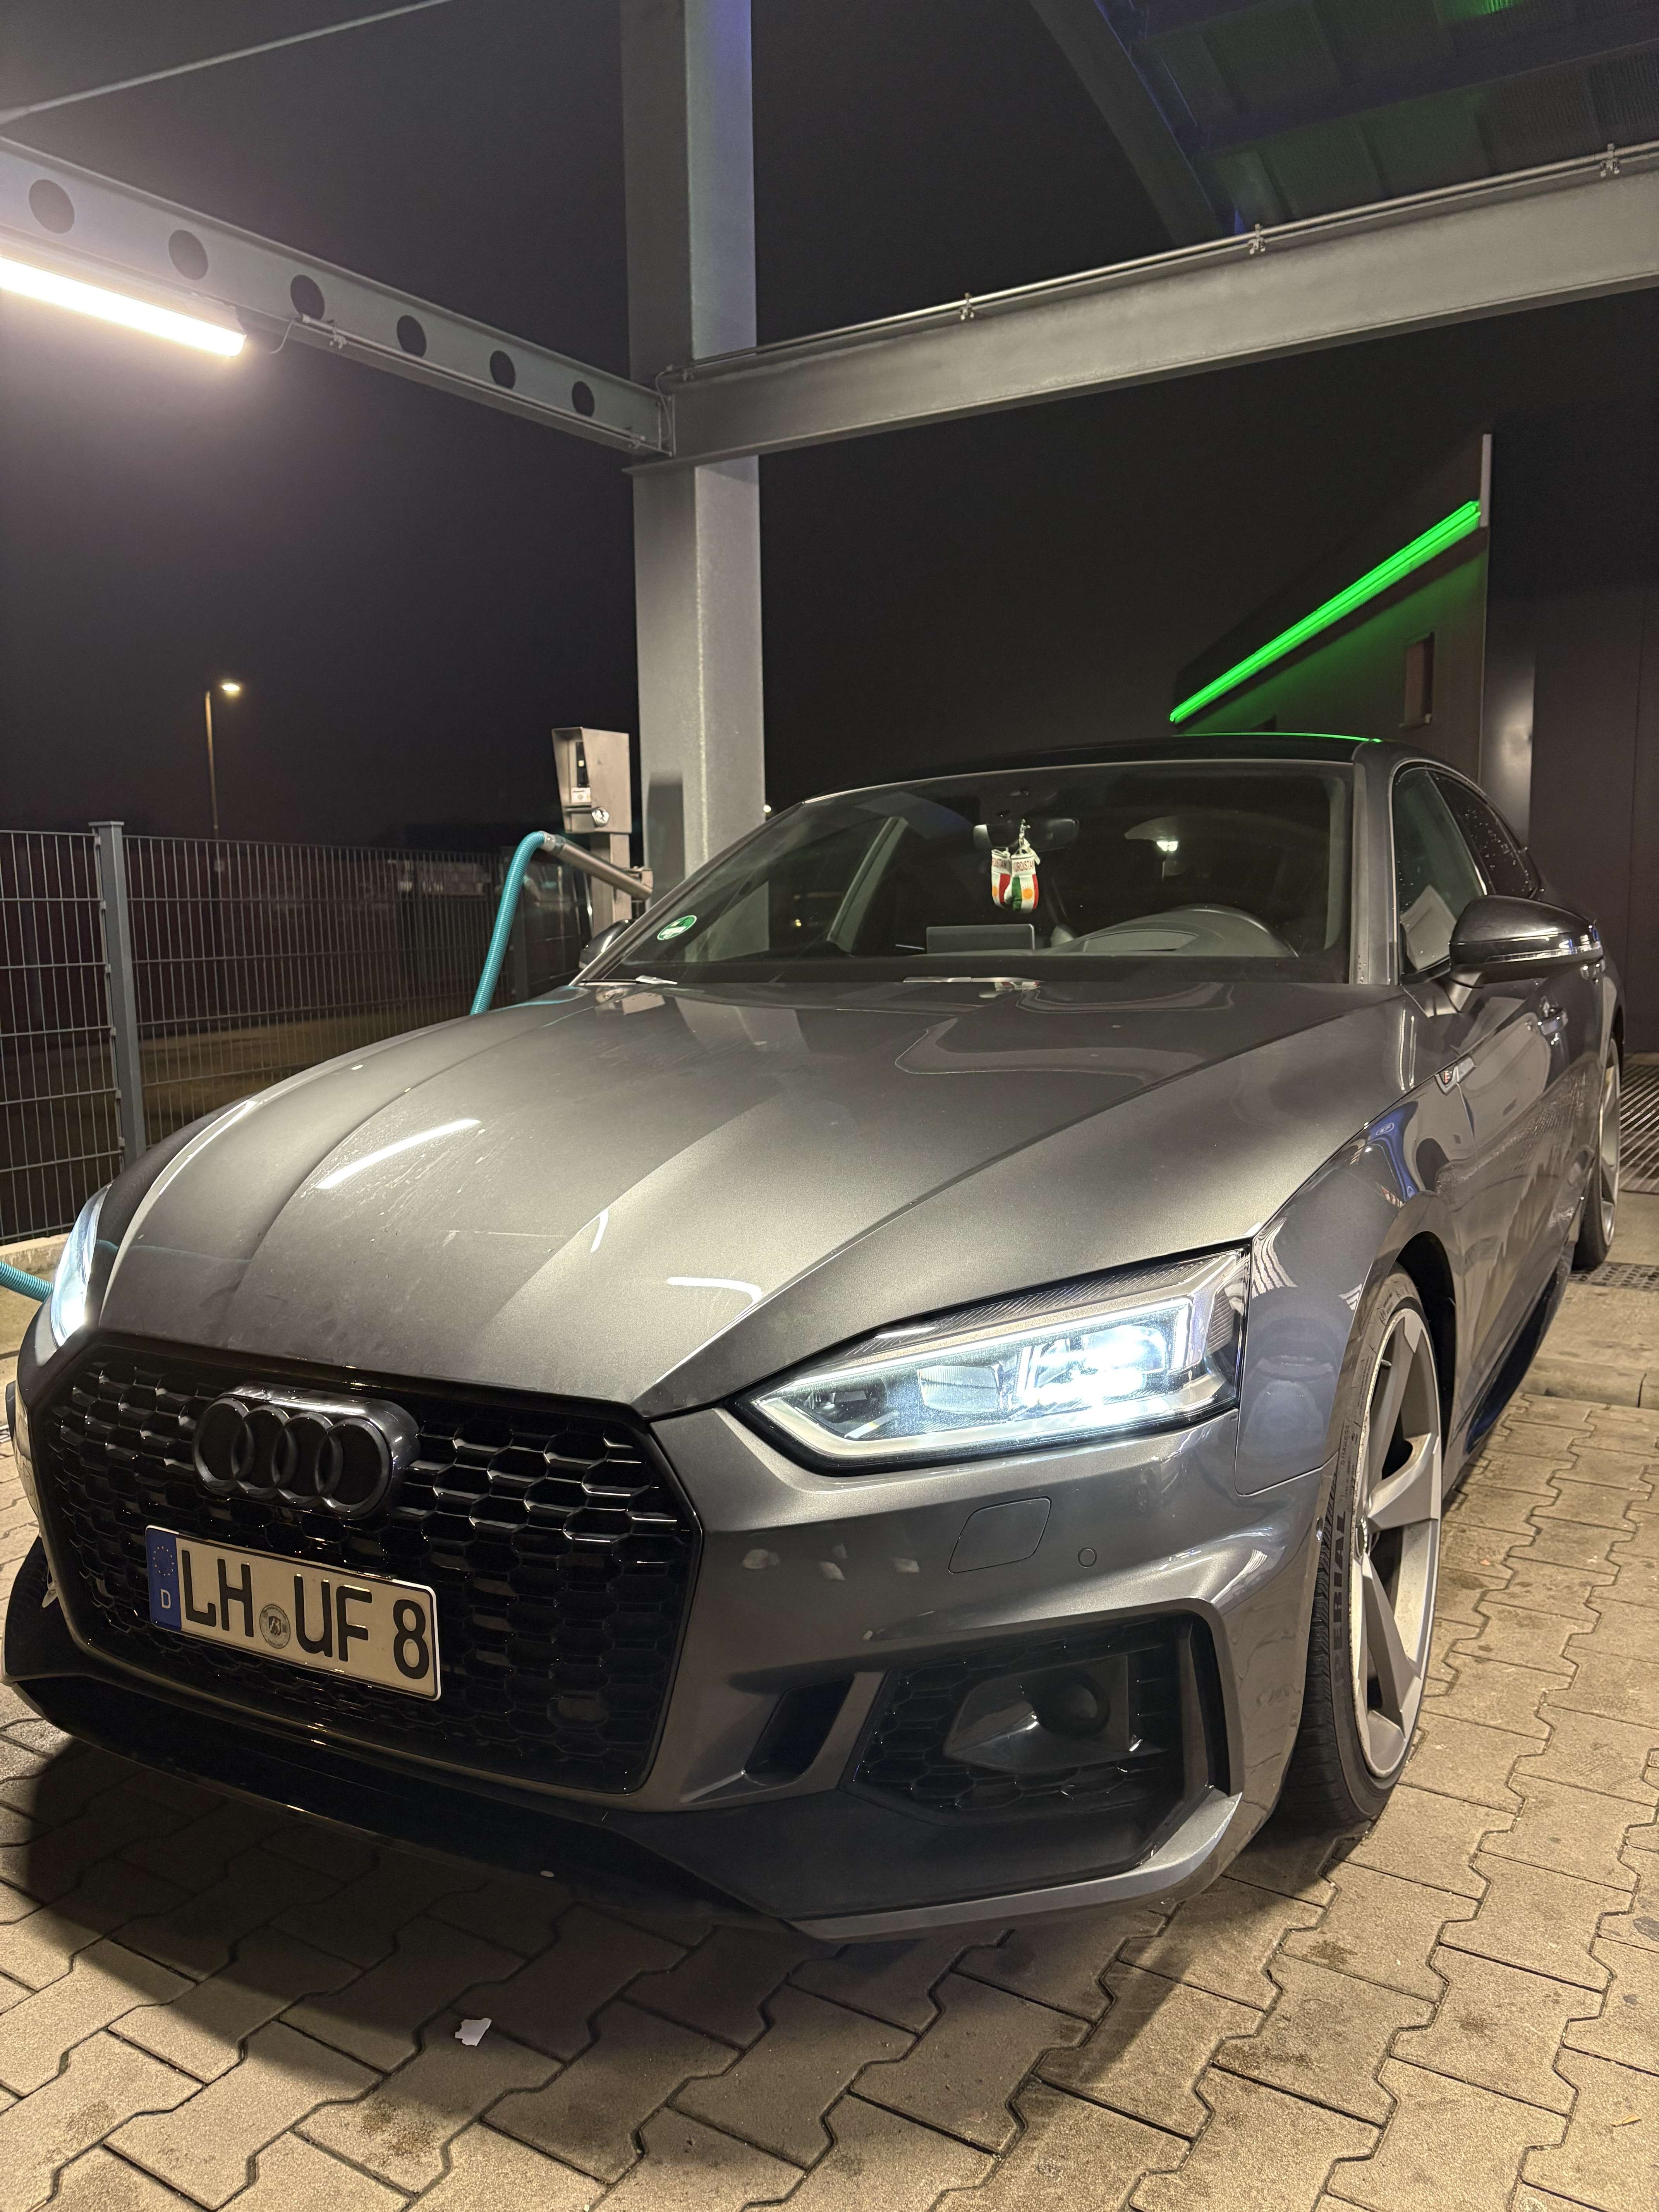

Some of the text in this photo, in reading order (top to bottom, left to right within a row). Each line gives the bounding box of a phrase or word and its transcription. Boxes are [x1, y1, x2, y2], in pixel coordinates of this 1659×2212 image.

[160, 1589, 171, 1609] D
[181, 1550, 429, 1679] LH UF 8
[1333, 1511, 1346, 1704] PERIAL
